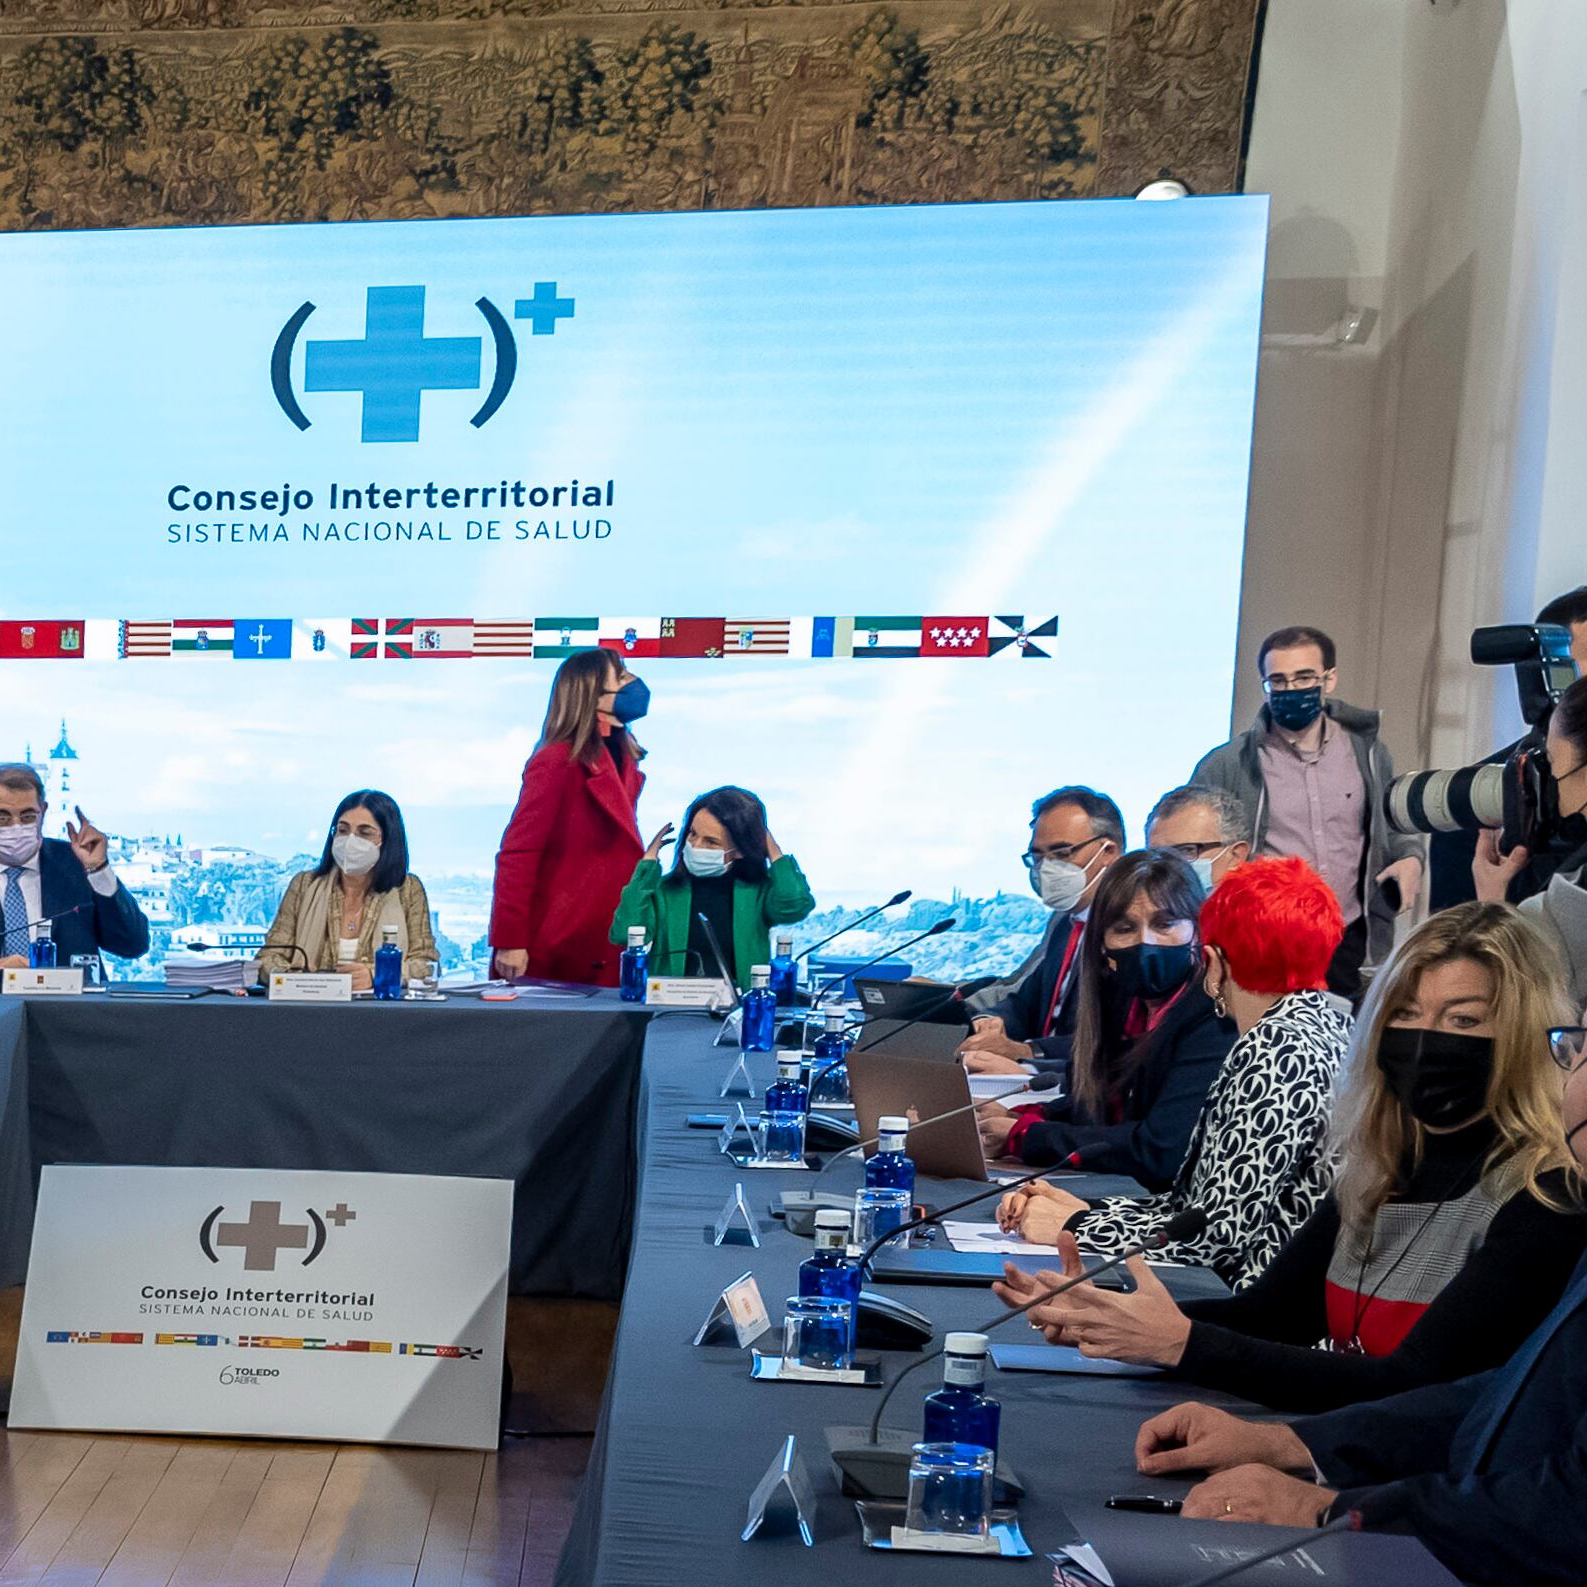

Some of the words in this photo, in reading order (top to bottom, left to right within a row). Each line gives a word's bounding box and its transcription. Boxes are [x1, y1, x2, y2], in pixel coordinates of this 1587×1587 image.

[167, 484, 314, 517] Consejo
[329, 479, 615, 511] Interterritorial
[167, 523, 290, 543] SISTEMA
[302, 520, 452, 543] NACIONAL
[466, 520, 502, 541] DE
[515, 518, 613, 541] SALUD
[141, 1285, 218, 1303] Consejo
[226, 1287, 375, 1306] Interterritorial
[139, 1303, 205, 1316] SISTEMA
[211, 1305, 289, 1319] NACIONAL
[296, 1308, 316, 1319] DE
[322, 1309, 374, 1322] SALUD
[219, 1365, 234, 1385] 6
[234, 1367, 280, 1378] TOLEDO
